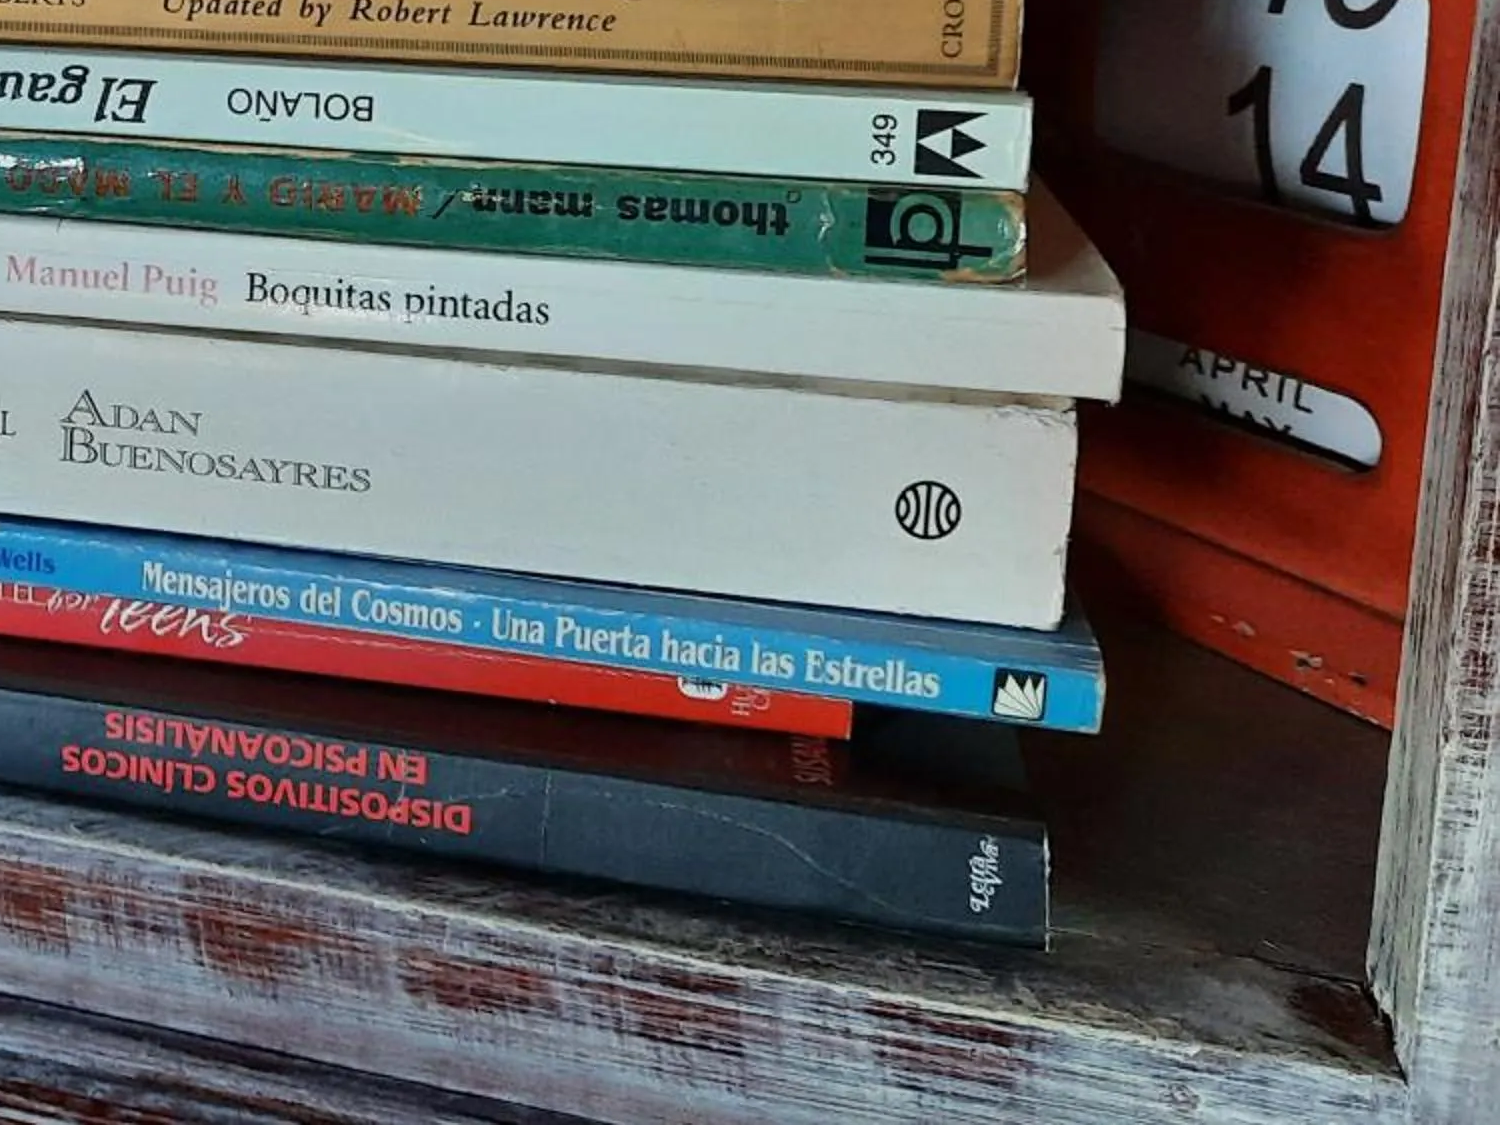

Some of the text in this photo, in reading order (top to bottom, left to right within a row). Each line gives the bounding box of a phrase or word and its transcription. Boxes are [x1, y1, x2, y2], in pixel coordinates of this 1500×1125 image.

[468, 0, 617, 34] Lawrence
[94, 75, 157, 123] El
[226, 86, 374, 123] BOLAÑO
[869, 112, 898, 166] 349
[1228, 65, 1382, 223] 14
[156, 170, 198, 203] EL
[222, 173, 248, 206] Y
[472, 188, 593, 219] mann
[617, 191, 790, 237] thomas
[6, 253, 552, 325] Manuel Puig Boquitas pintadas
[1179, 347, 1314, 414] APRIL
[141, 558, 291, 616] Mensajeros
[299, 579, 343, 619] del
[350, 586, 464, 635] Cosmos
[490, 605, 547, 645] Una
[554, 615, 653, 661] Puerta
[660, 630, 742, 673] hacia
[750, 639, 796, 680] las
[804, 648, 942, 700] Estrellas
[104, 711, 428, 787] EN PSICOANÁLISIS
[62, 743, 472, 837] DISPOSITIVOS CLÍNICOS
